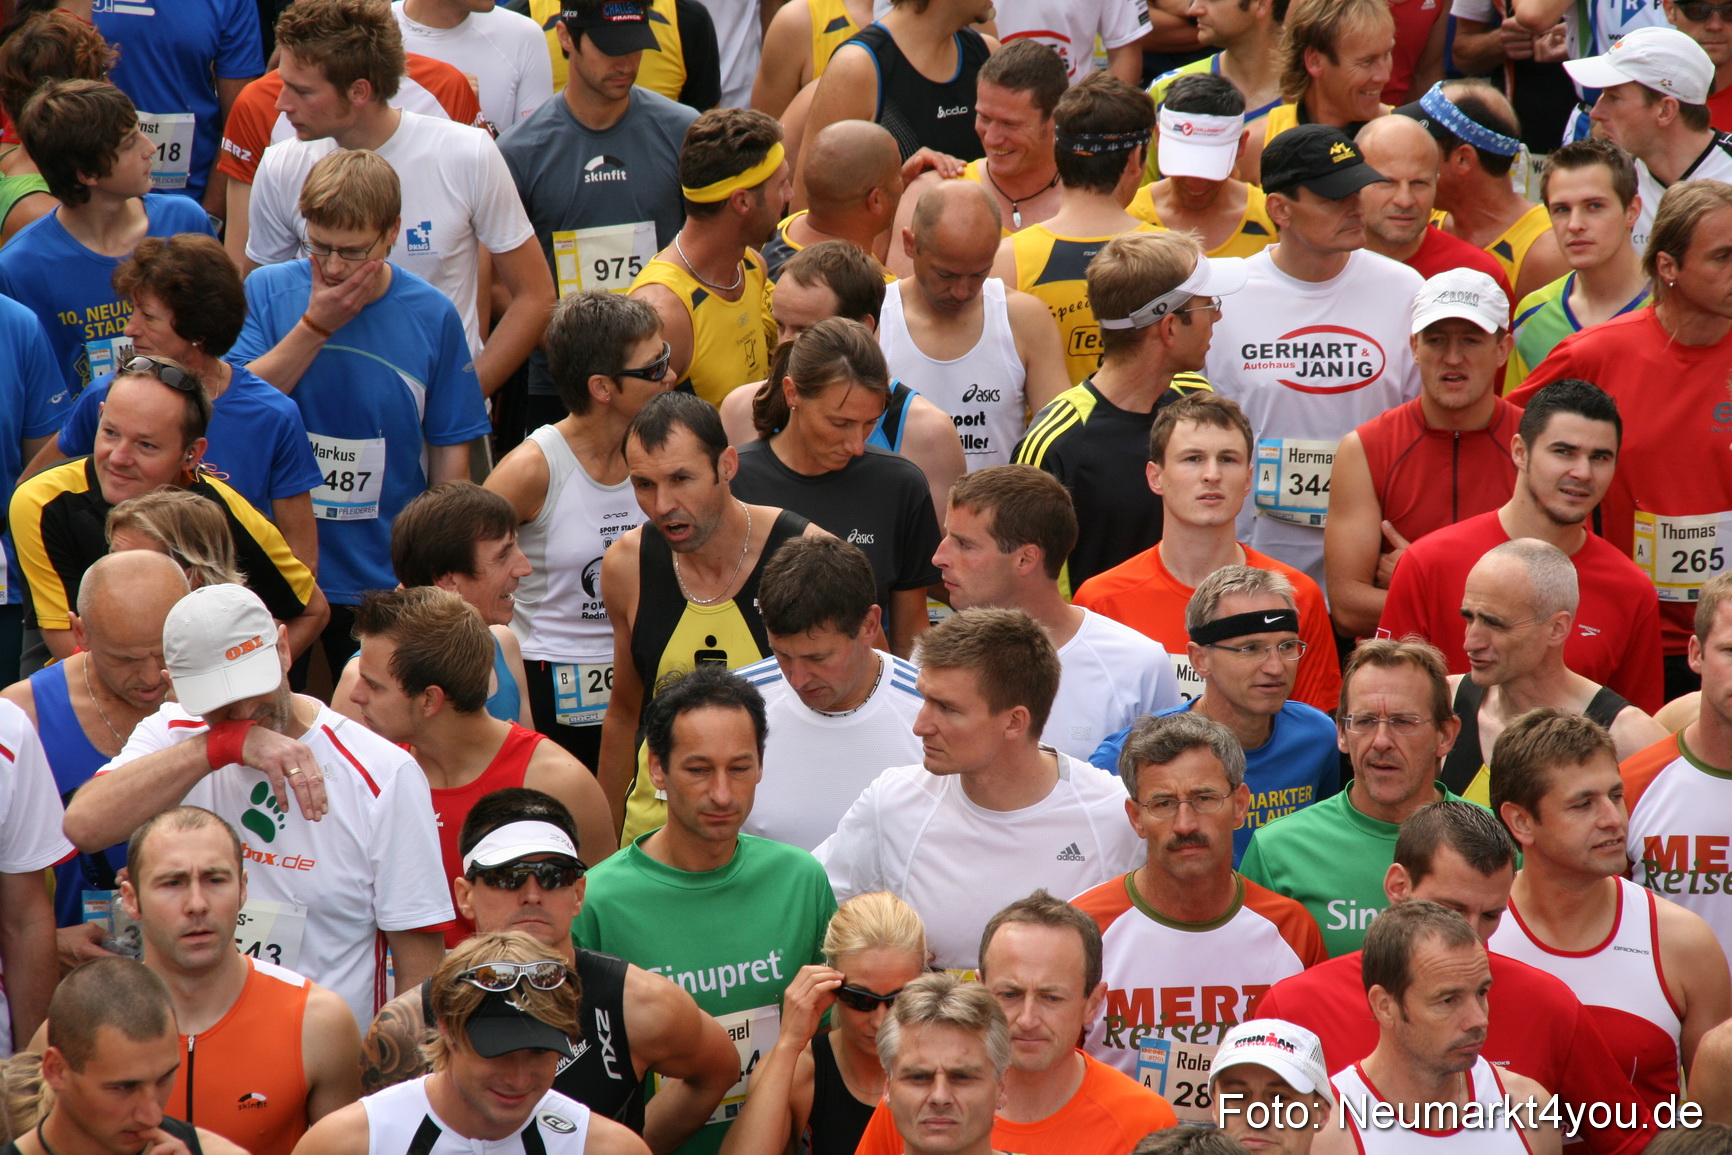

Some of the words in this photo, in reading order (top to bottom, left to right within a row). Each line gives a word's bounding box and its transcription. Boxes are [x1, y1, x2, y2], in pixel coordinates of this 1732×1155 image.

[584, 170, 627, 183] skinfit
[594, 256, 643, 281] 975
[58, 311, 84, 325] 10.
[1241, 343, 1357, 359] GERHART
[1361, 348, 1370, 357] &
[1243, 361, 1296, 370] Autohaus
[969, 386, 1000, 403] asics
[324, 470, 371, 492] 487
[1264, 470, 1270, 481] A
[338, 506, 376, 515] PFLEIDERER
[851, 531, 874, 544] asics
[1661, 523, 1716, 539] Thomas
[1637, 545, 1644, 556] A
[1671, 547, 1725, 573] 265
[225, 635, 264, 660] OBI
[561, 673, 568, 684] B
[1056, 853, 1085, 861] adidas
[1614, 946, 1649, 955] BROOKS
[1144, 1075, 1151, 1088] A
